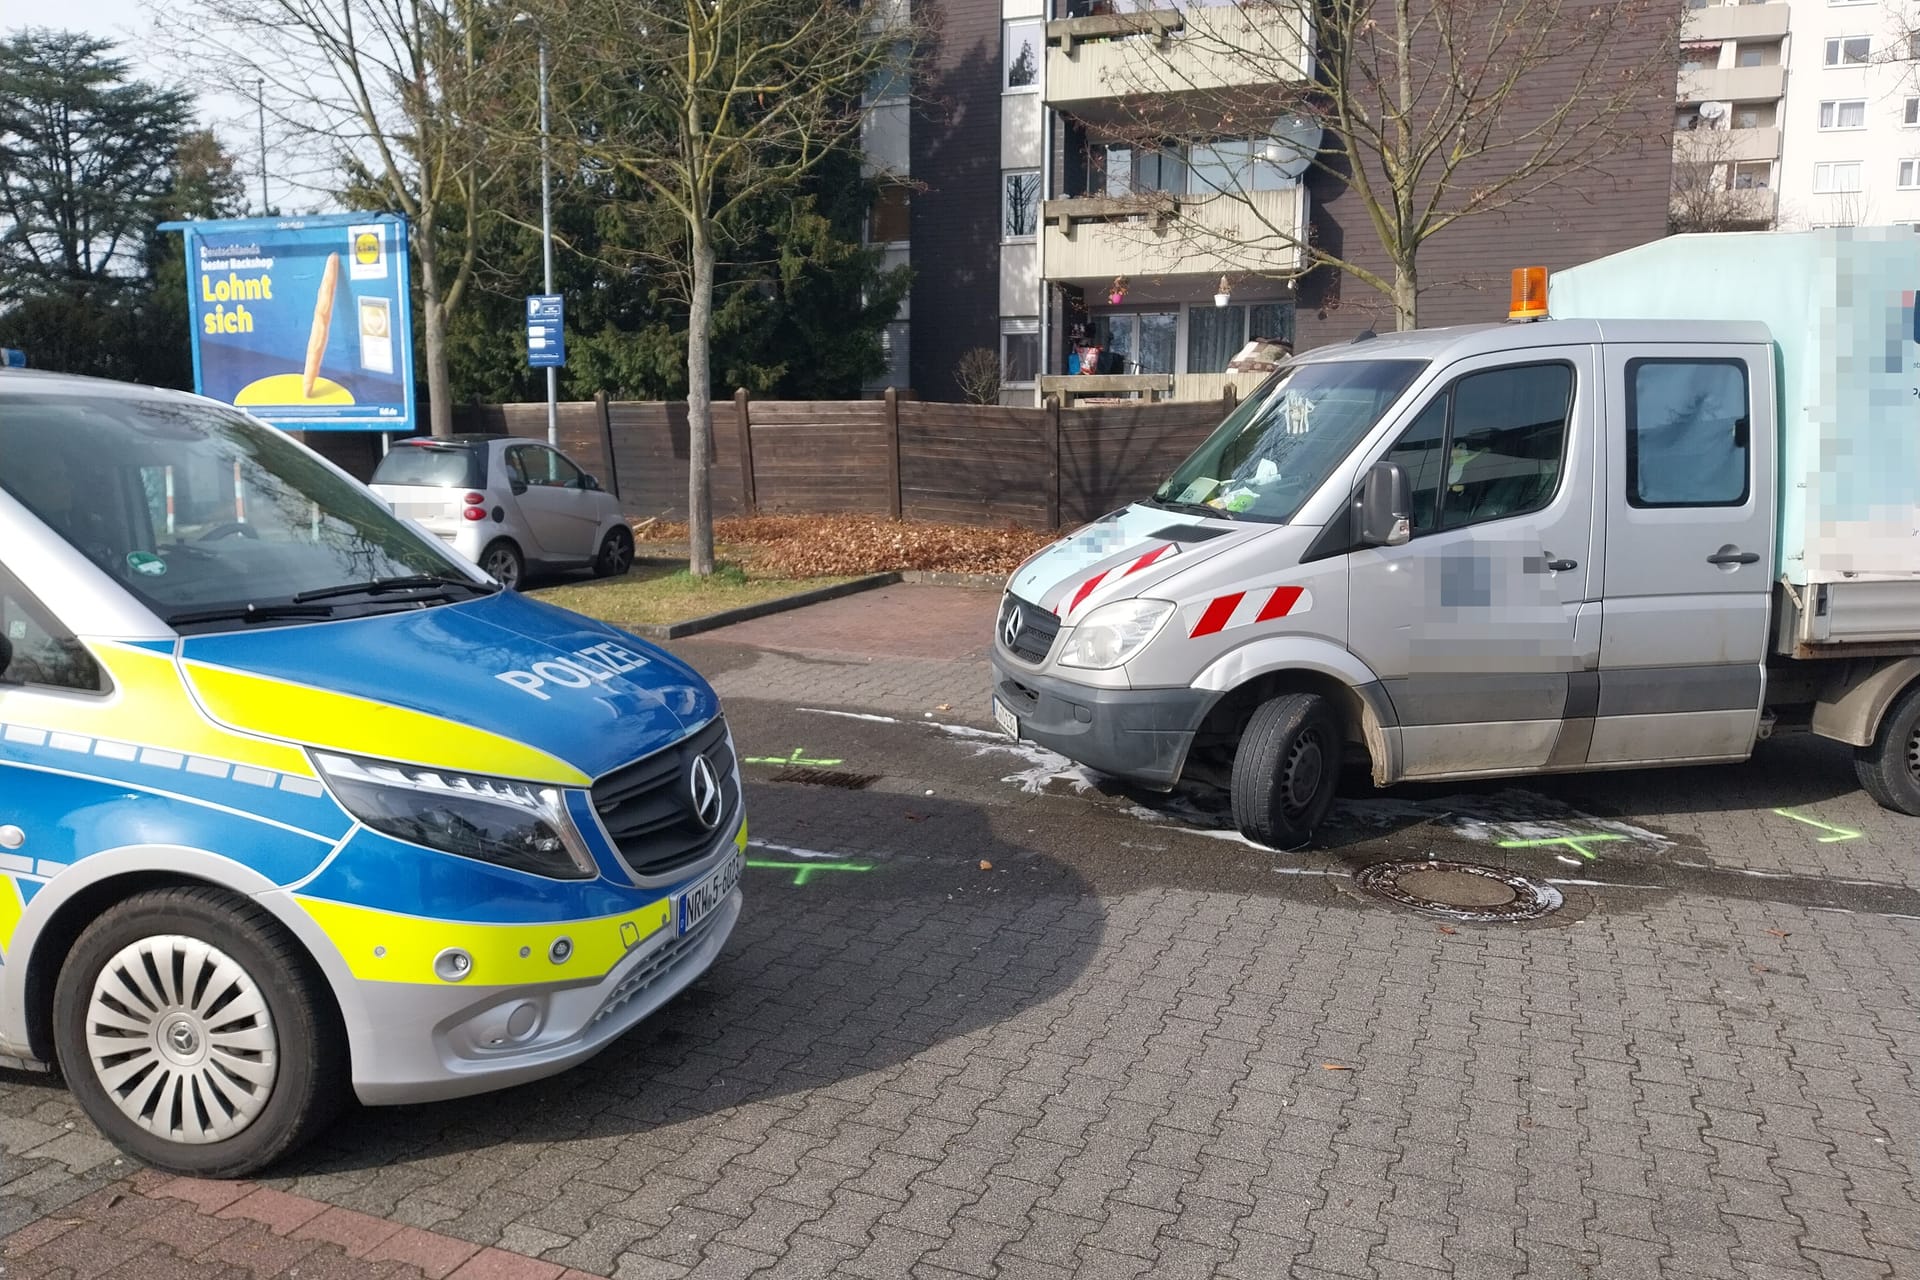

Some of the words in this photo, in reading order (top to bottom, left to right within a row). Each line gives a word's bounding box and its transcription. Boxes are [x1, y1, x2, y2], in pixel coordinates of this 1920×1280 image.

[202, 272, 272, 302] Lohnt
[204, 304, 254, 334] sich
[530, 299, 540, 315] P
[495, 641, 650, 700] POLIZEI
